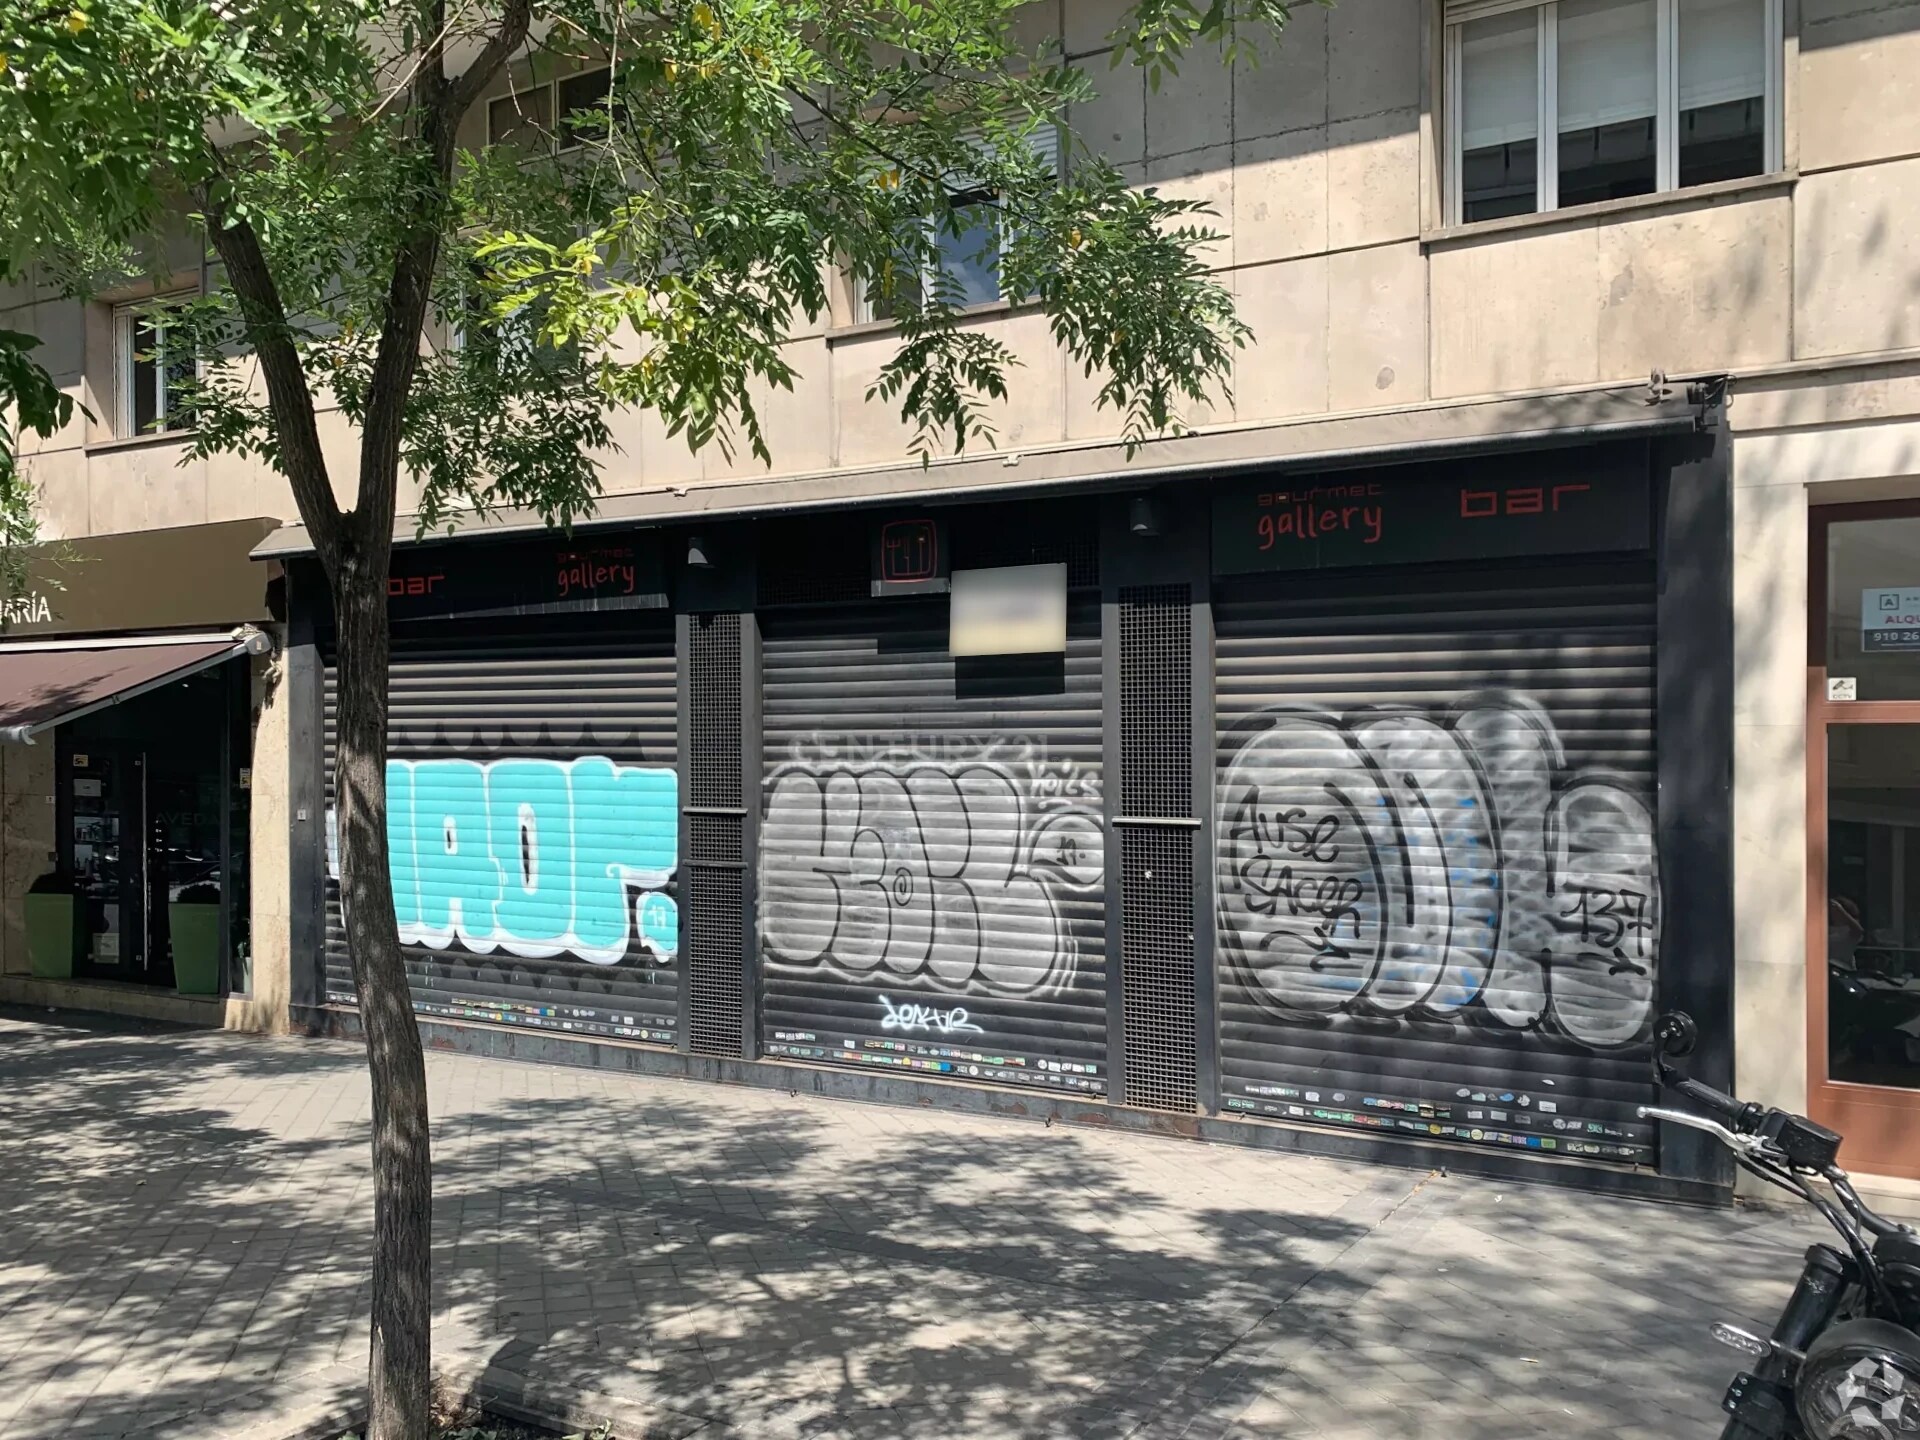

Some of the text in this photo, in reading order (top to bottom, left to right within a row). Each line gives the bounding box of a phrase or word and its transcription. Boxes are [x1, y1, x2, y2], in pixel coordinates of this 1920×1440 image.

[1256, 483, 1383, 506] gourmet
[1460, 484, 1591, 518] bar
[1257, 503, 1383, 551] gallery
[557, 560, 634, 597] gallery
[0, 590, 52, 625] ARÍA
[1874, 632, 1899, 641] 910
